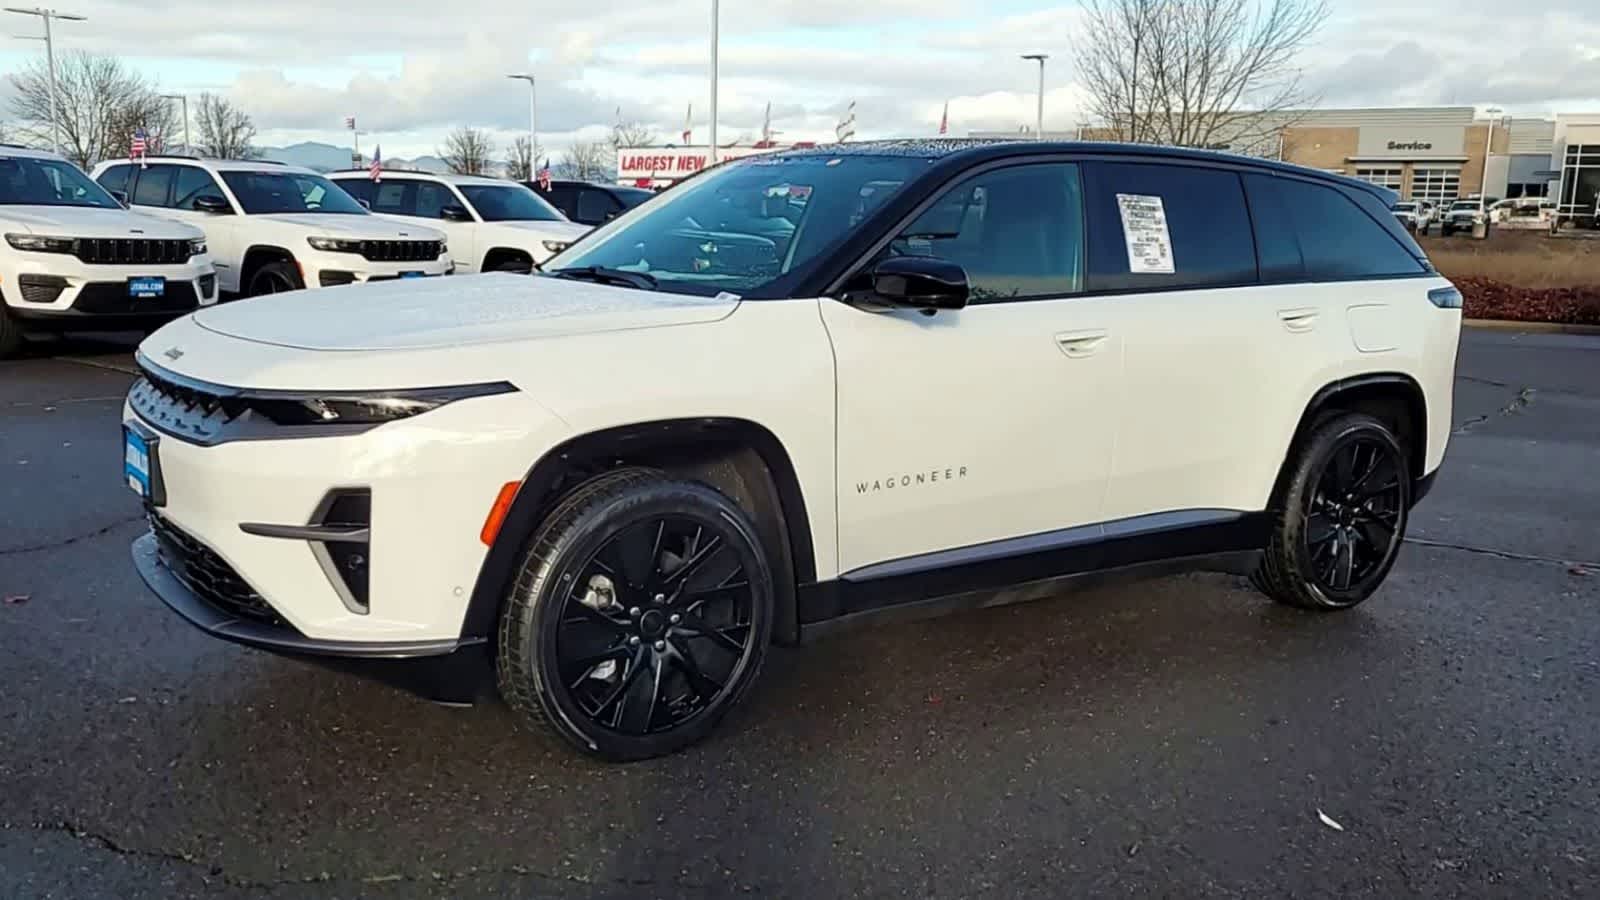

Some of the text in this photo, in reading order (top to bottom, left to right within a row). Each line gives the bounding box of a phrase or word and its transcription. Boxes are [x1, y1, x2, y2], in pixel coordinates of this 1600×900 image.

[1387, 140, 1432, 150] Service
[621, 155, 674, 171] LARGEST
[677, 155, 706, 171] NEW
[856, 465, 968, 494] WAGONEER
